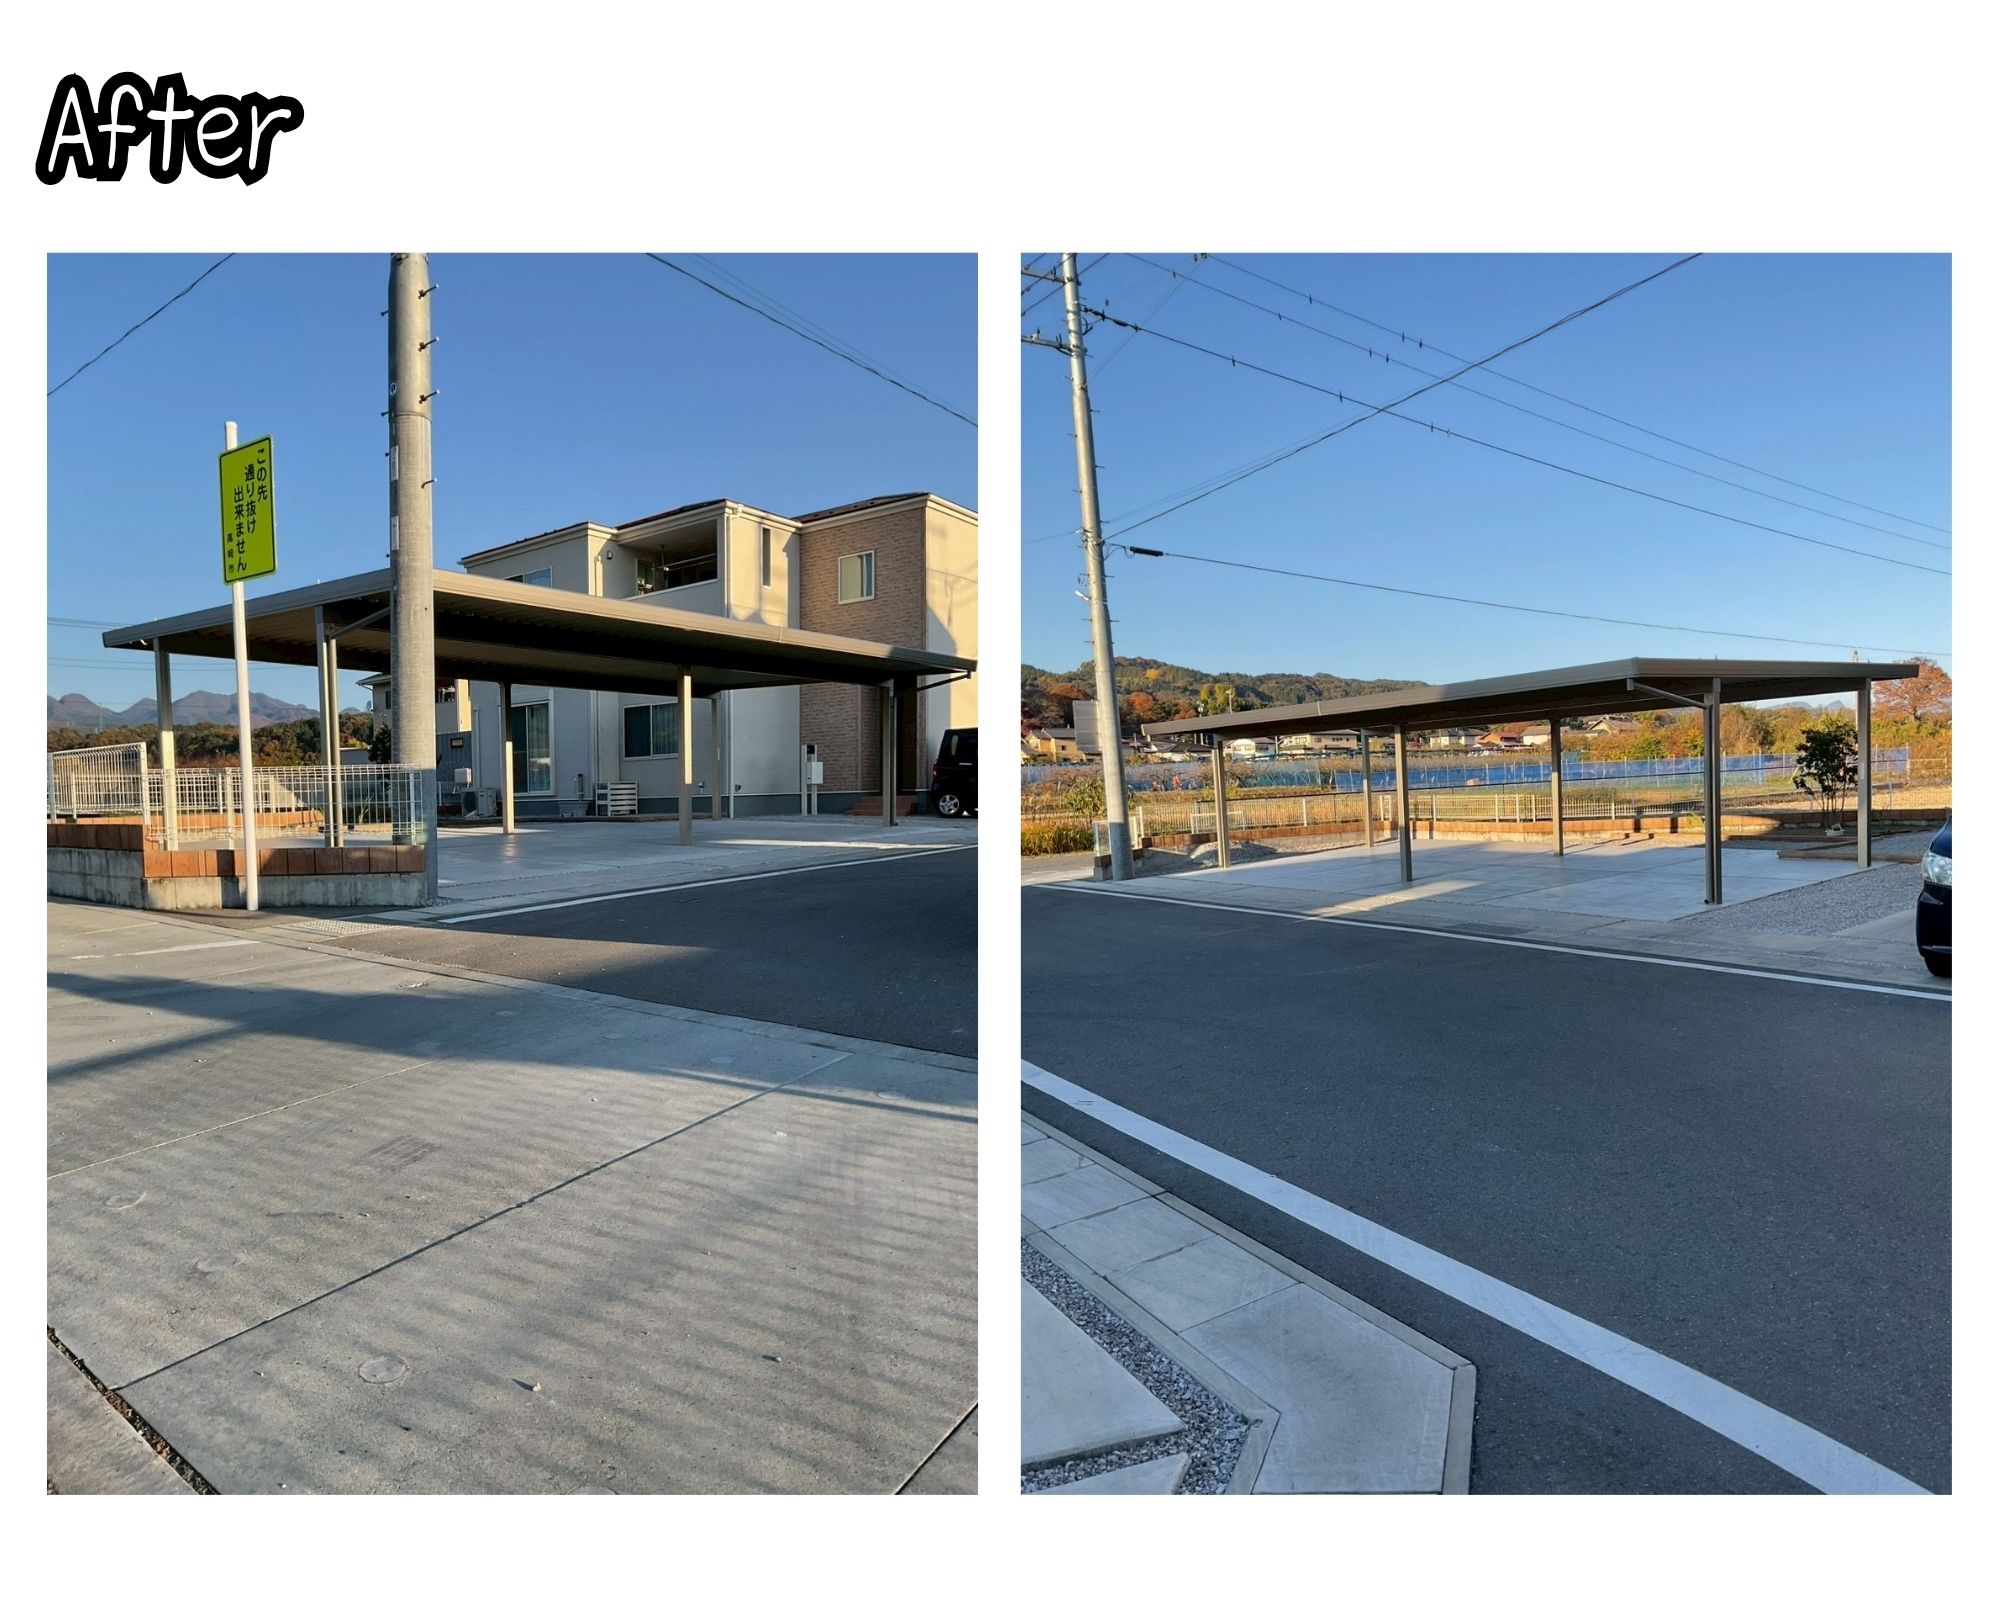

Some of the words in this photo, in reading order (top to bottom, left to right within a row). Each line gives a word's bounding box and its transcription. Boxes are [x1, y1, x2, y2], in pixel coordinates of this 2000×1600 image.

[244, 463, 257, 534] 通り抜け
[256, 448, 268, 501] この先
[233, 485, 247, 573] 出来ません
